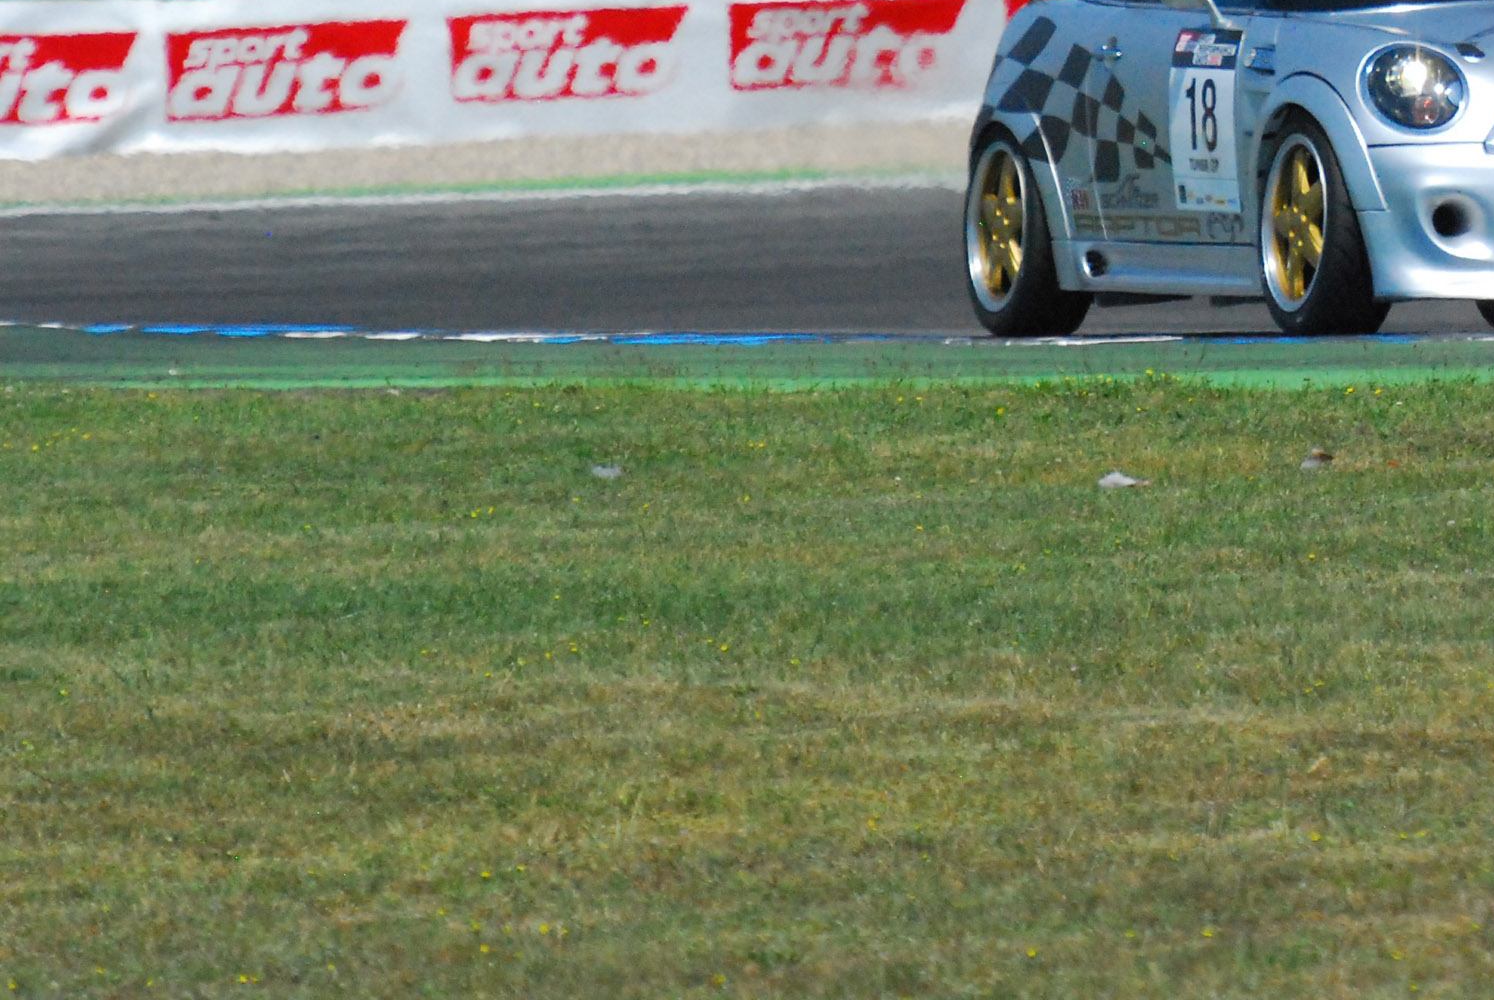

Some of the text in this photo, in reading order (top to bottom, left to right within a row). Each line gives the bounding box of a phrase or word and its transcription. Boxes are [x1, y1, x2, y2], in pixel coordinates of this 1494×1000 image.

[182, 28, 309, 70] sport
[467, 14, 589, 53] sport
[747, 3, 869, 42] sport
[168, 51, 402, 120] auto
[454, 38, 674, 99] auto
[731, 26, 945, 87] auto
[0, 61, 126, 122] to
[1186, 78, 1217, 152] 18
